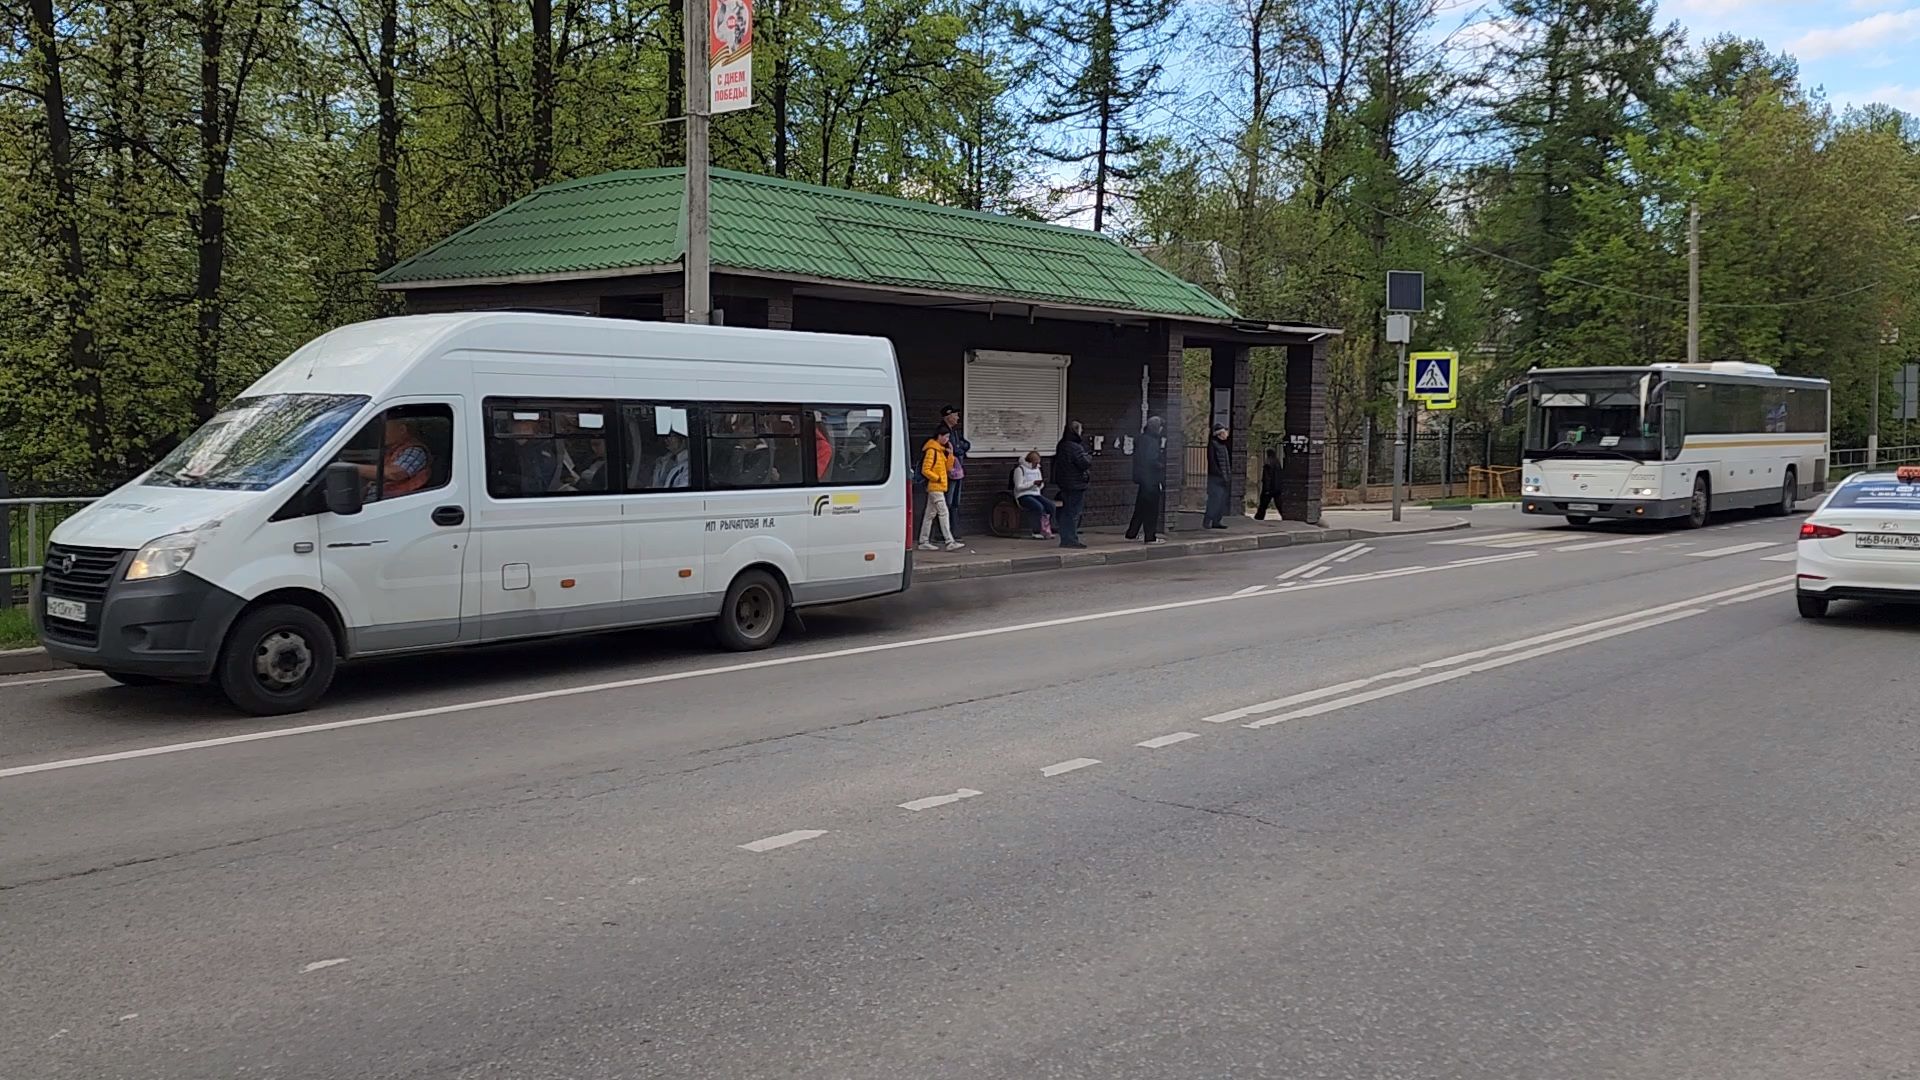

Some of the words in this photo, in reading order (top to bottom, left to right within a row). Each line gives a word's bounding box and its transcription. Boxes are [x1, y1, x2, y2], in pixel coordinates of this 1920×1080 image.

[717, 75, 722, 86] С
[724, 71, 745, 85] ДНЕМ
[715, 87, 747, 101] ПОБЕДЫ!
[705, 521, 716, 532] ИП
[720, 519, 759, 531] РЫЧАГОВА
